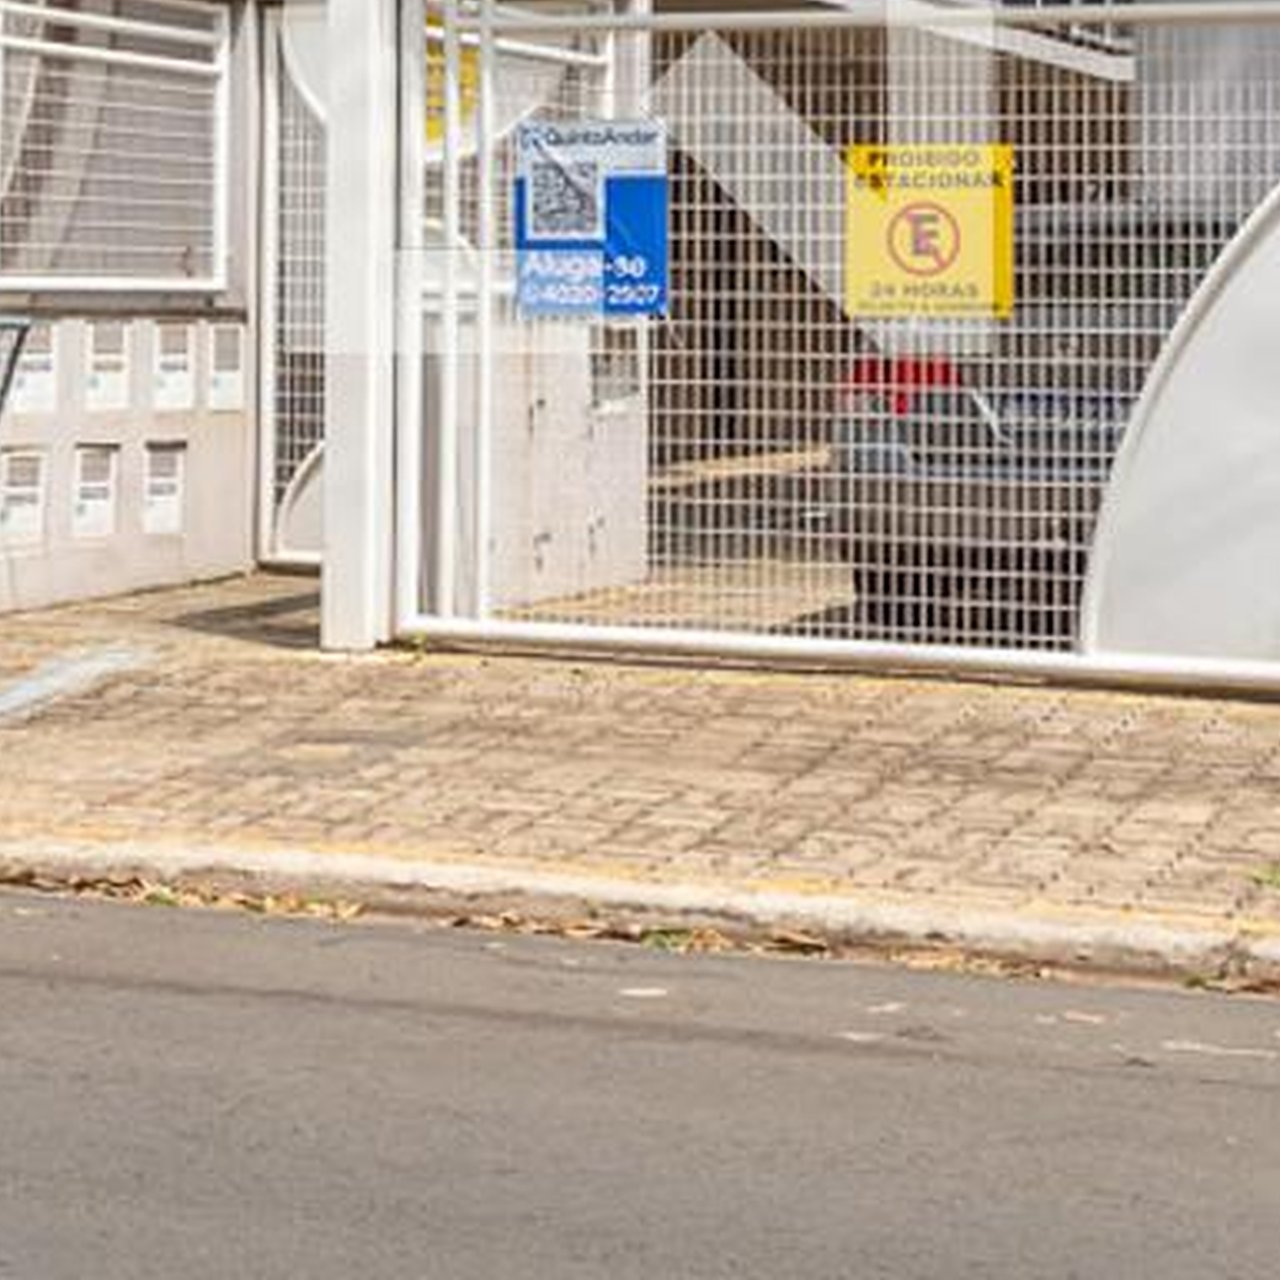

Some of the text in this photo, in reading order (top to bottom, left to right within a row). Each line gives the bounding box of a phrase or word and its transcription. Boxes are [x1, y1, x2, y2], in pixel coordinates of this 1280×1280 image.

[868, 151, 982, 167] PROIBIDO
[854, 170, 1004, 188] ESTACIONAR
[902, 282, 979, 297] HORAS
